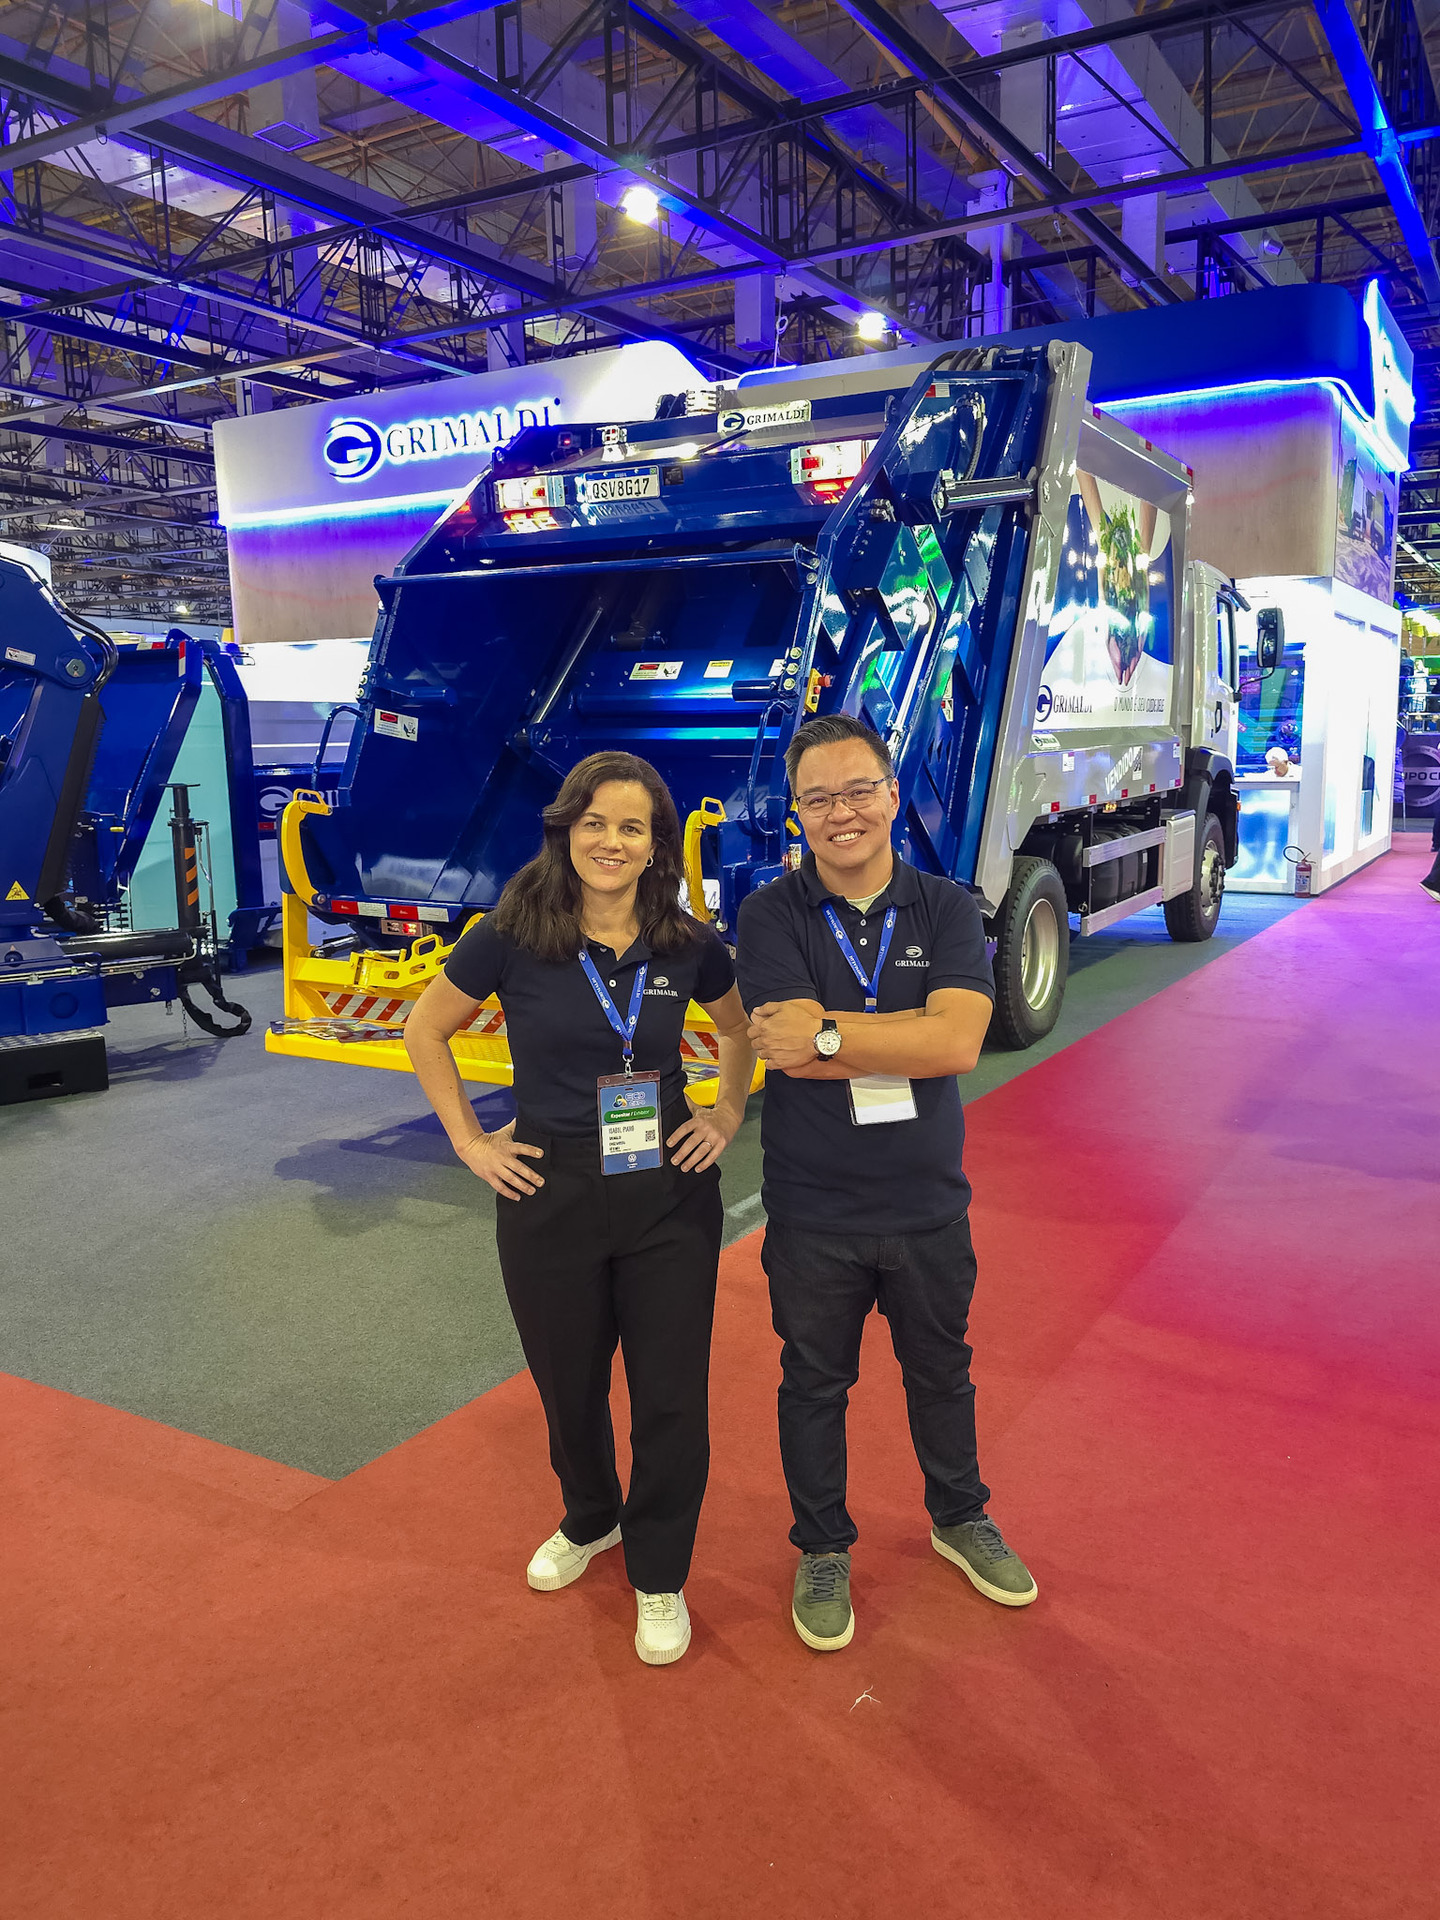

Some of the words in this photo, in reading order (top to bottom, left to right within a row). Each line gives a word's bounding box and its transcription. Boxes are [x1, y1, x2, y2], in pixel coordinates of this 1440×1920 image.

[747, 409, 805, 426] GRIMALDI
[386, 405, 551, 459] GRIMALDI
[592, 477, 650, 499] QSV8G17
[1053, 694, 1093, 714] GRIMALDI
[1104, 746, 1133, 795] VENDIDO
